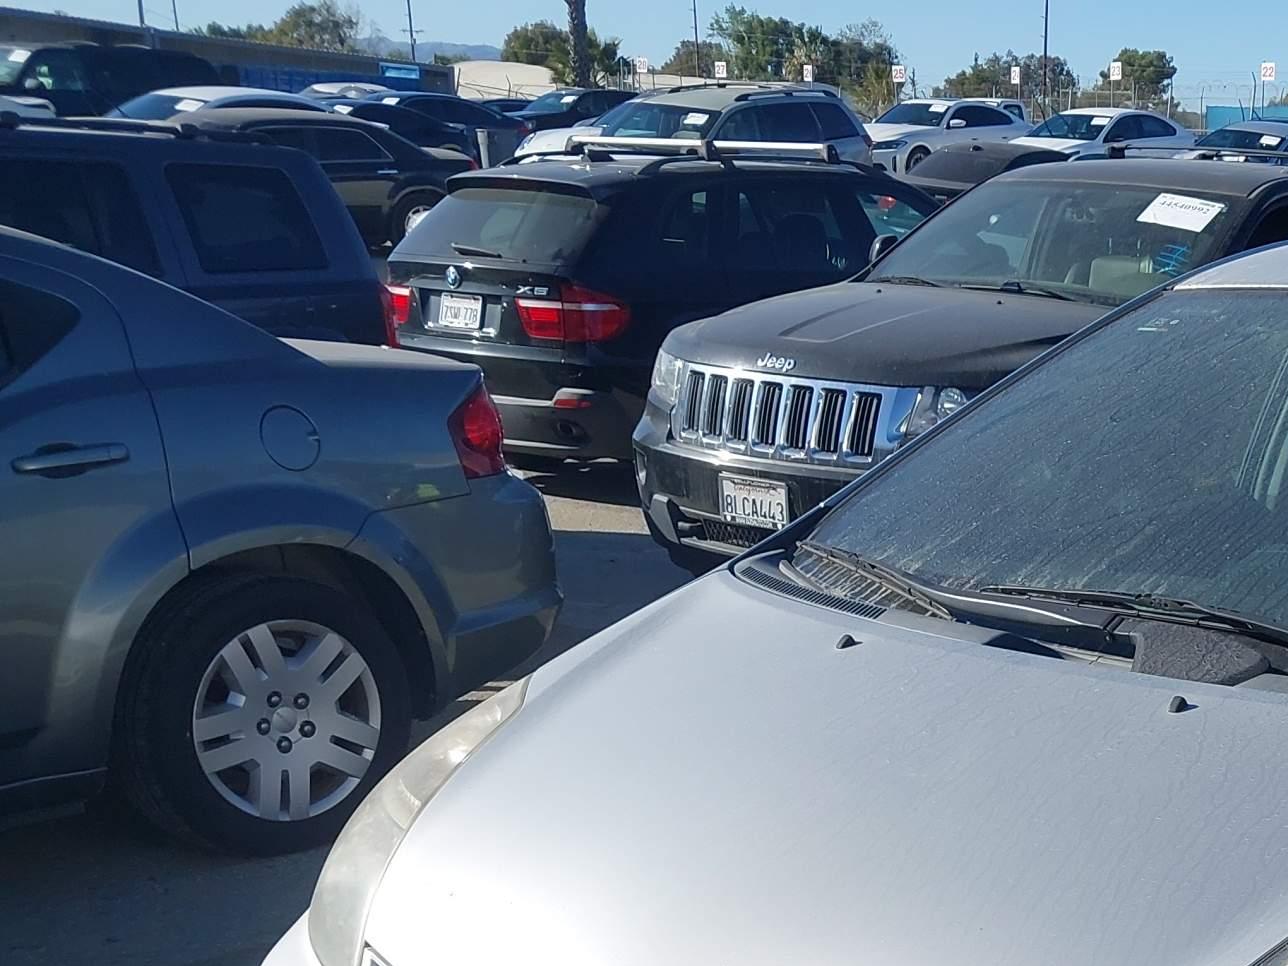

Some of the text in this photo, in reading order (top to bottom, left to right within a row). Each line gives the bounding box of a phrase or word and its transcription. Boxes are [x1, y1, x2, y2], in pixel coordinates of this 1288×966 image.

[716, 64, 726, 75] 27
[893, 68, 905, 79] 25
[1111, 65, 1121, 76] 23
[1262, 66, 1274, 77] 22
[756, 352, 795, 372] Jeep
[725, 494, 785, 522] 8LCA443
